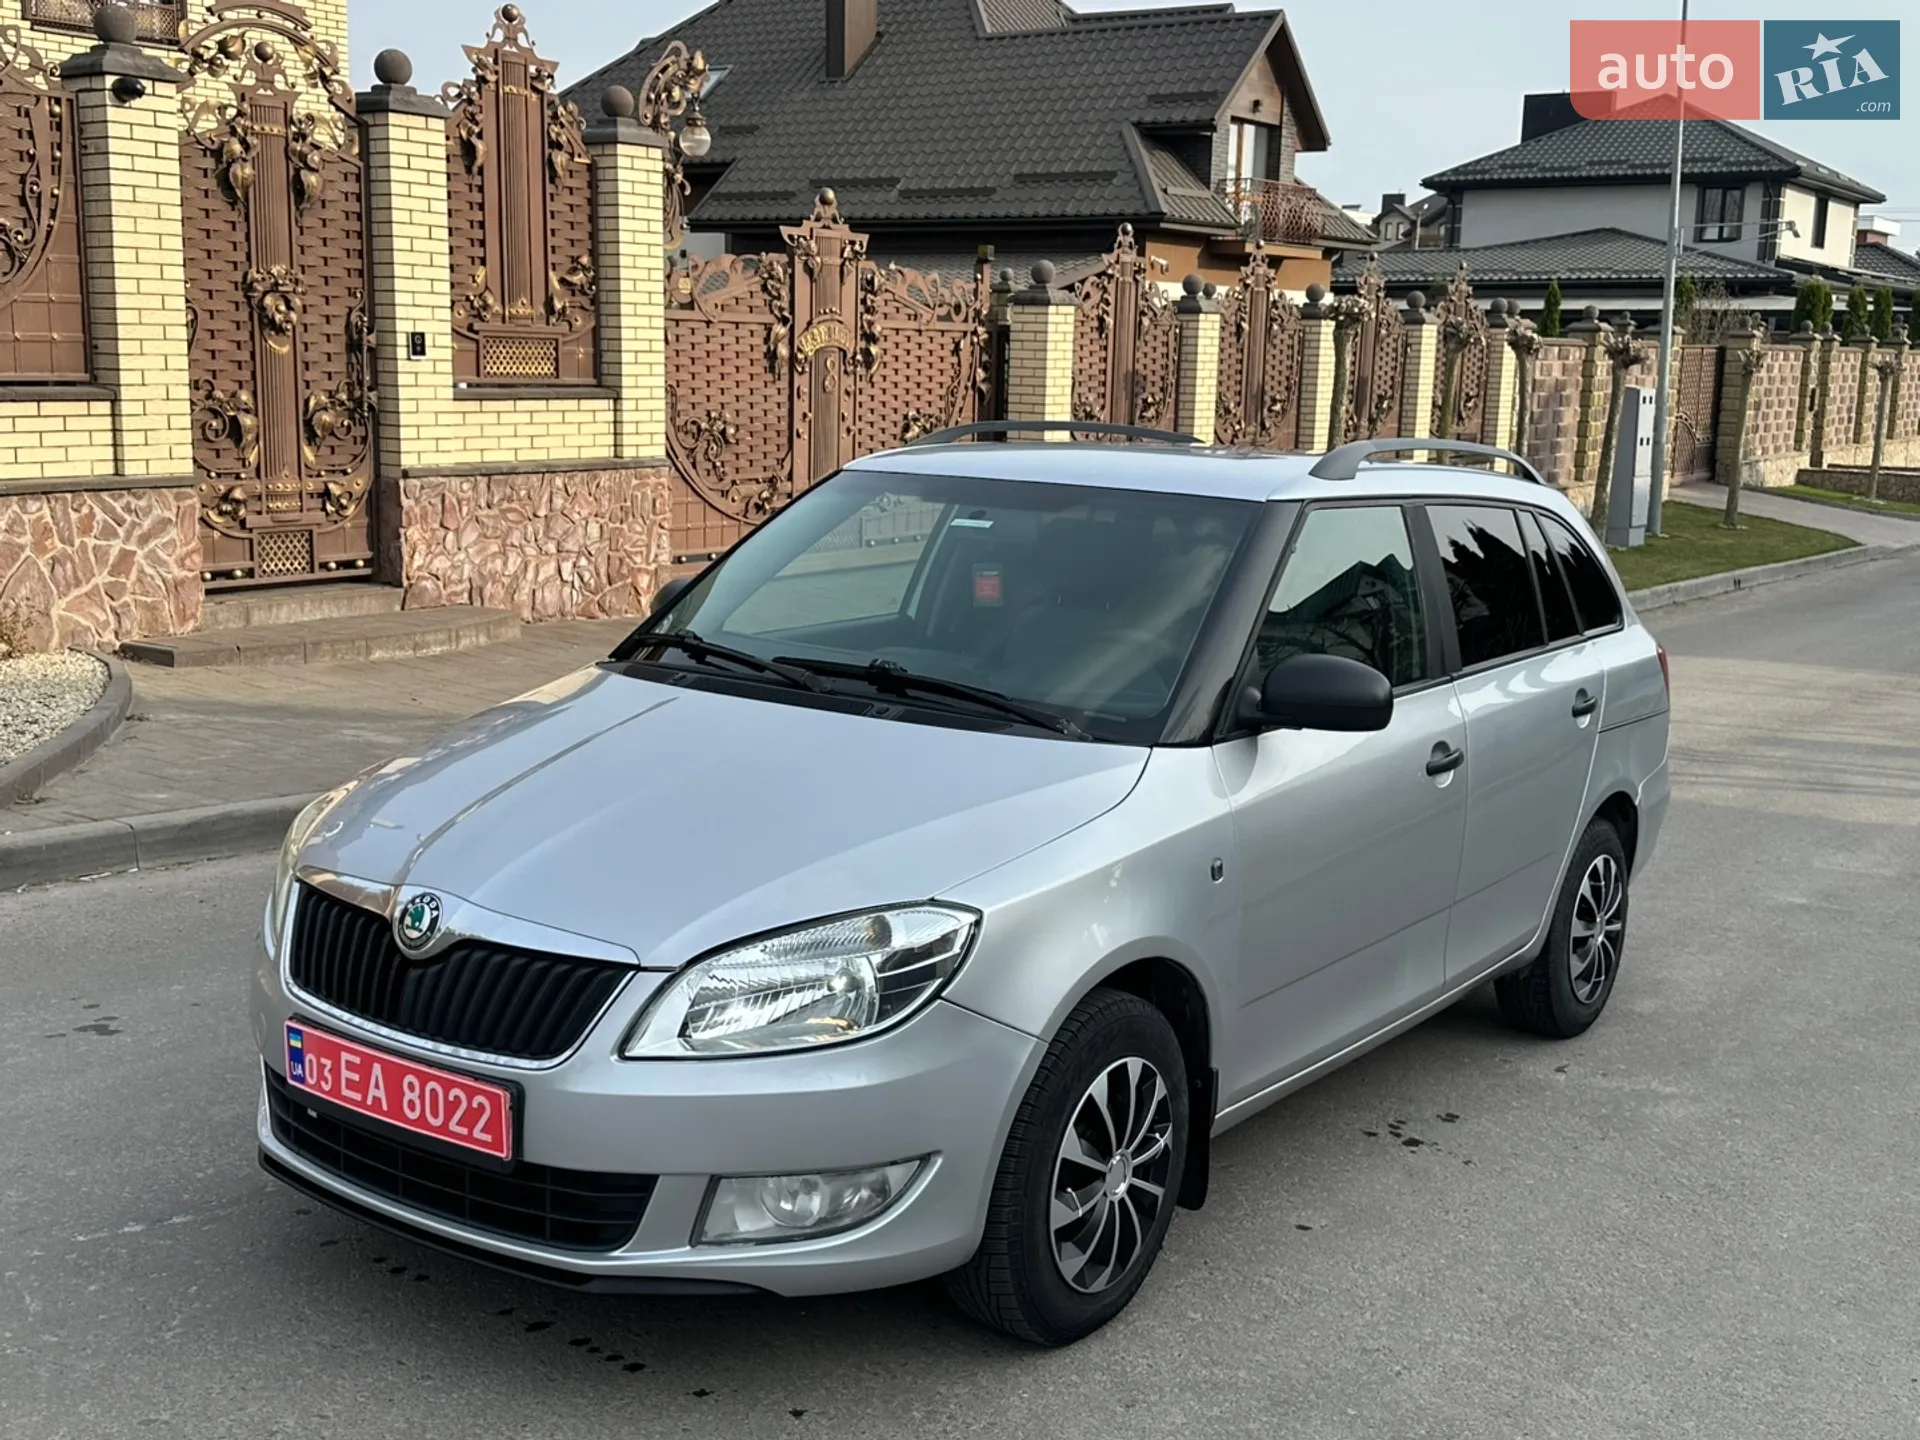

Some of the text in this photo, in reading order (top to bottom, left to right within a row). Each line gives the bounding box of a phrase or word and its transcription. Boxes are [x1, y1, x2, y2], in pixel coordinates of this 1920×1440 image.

[290, 1060, 304, 1078] UA
[304, 1051, 492, 1143] 03 EA 8022
